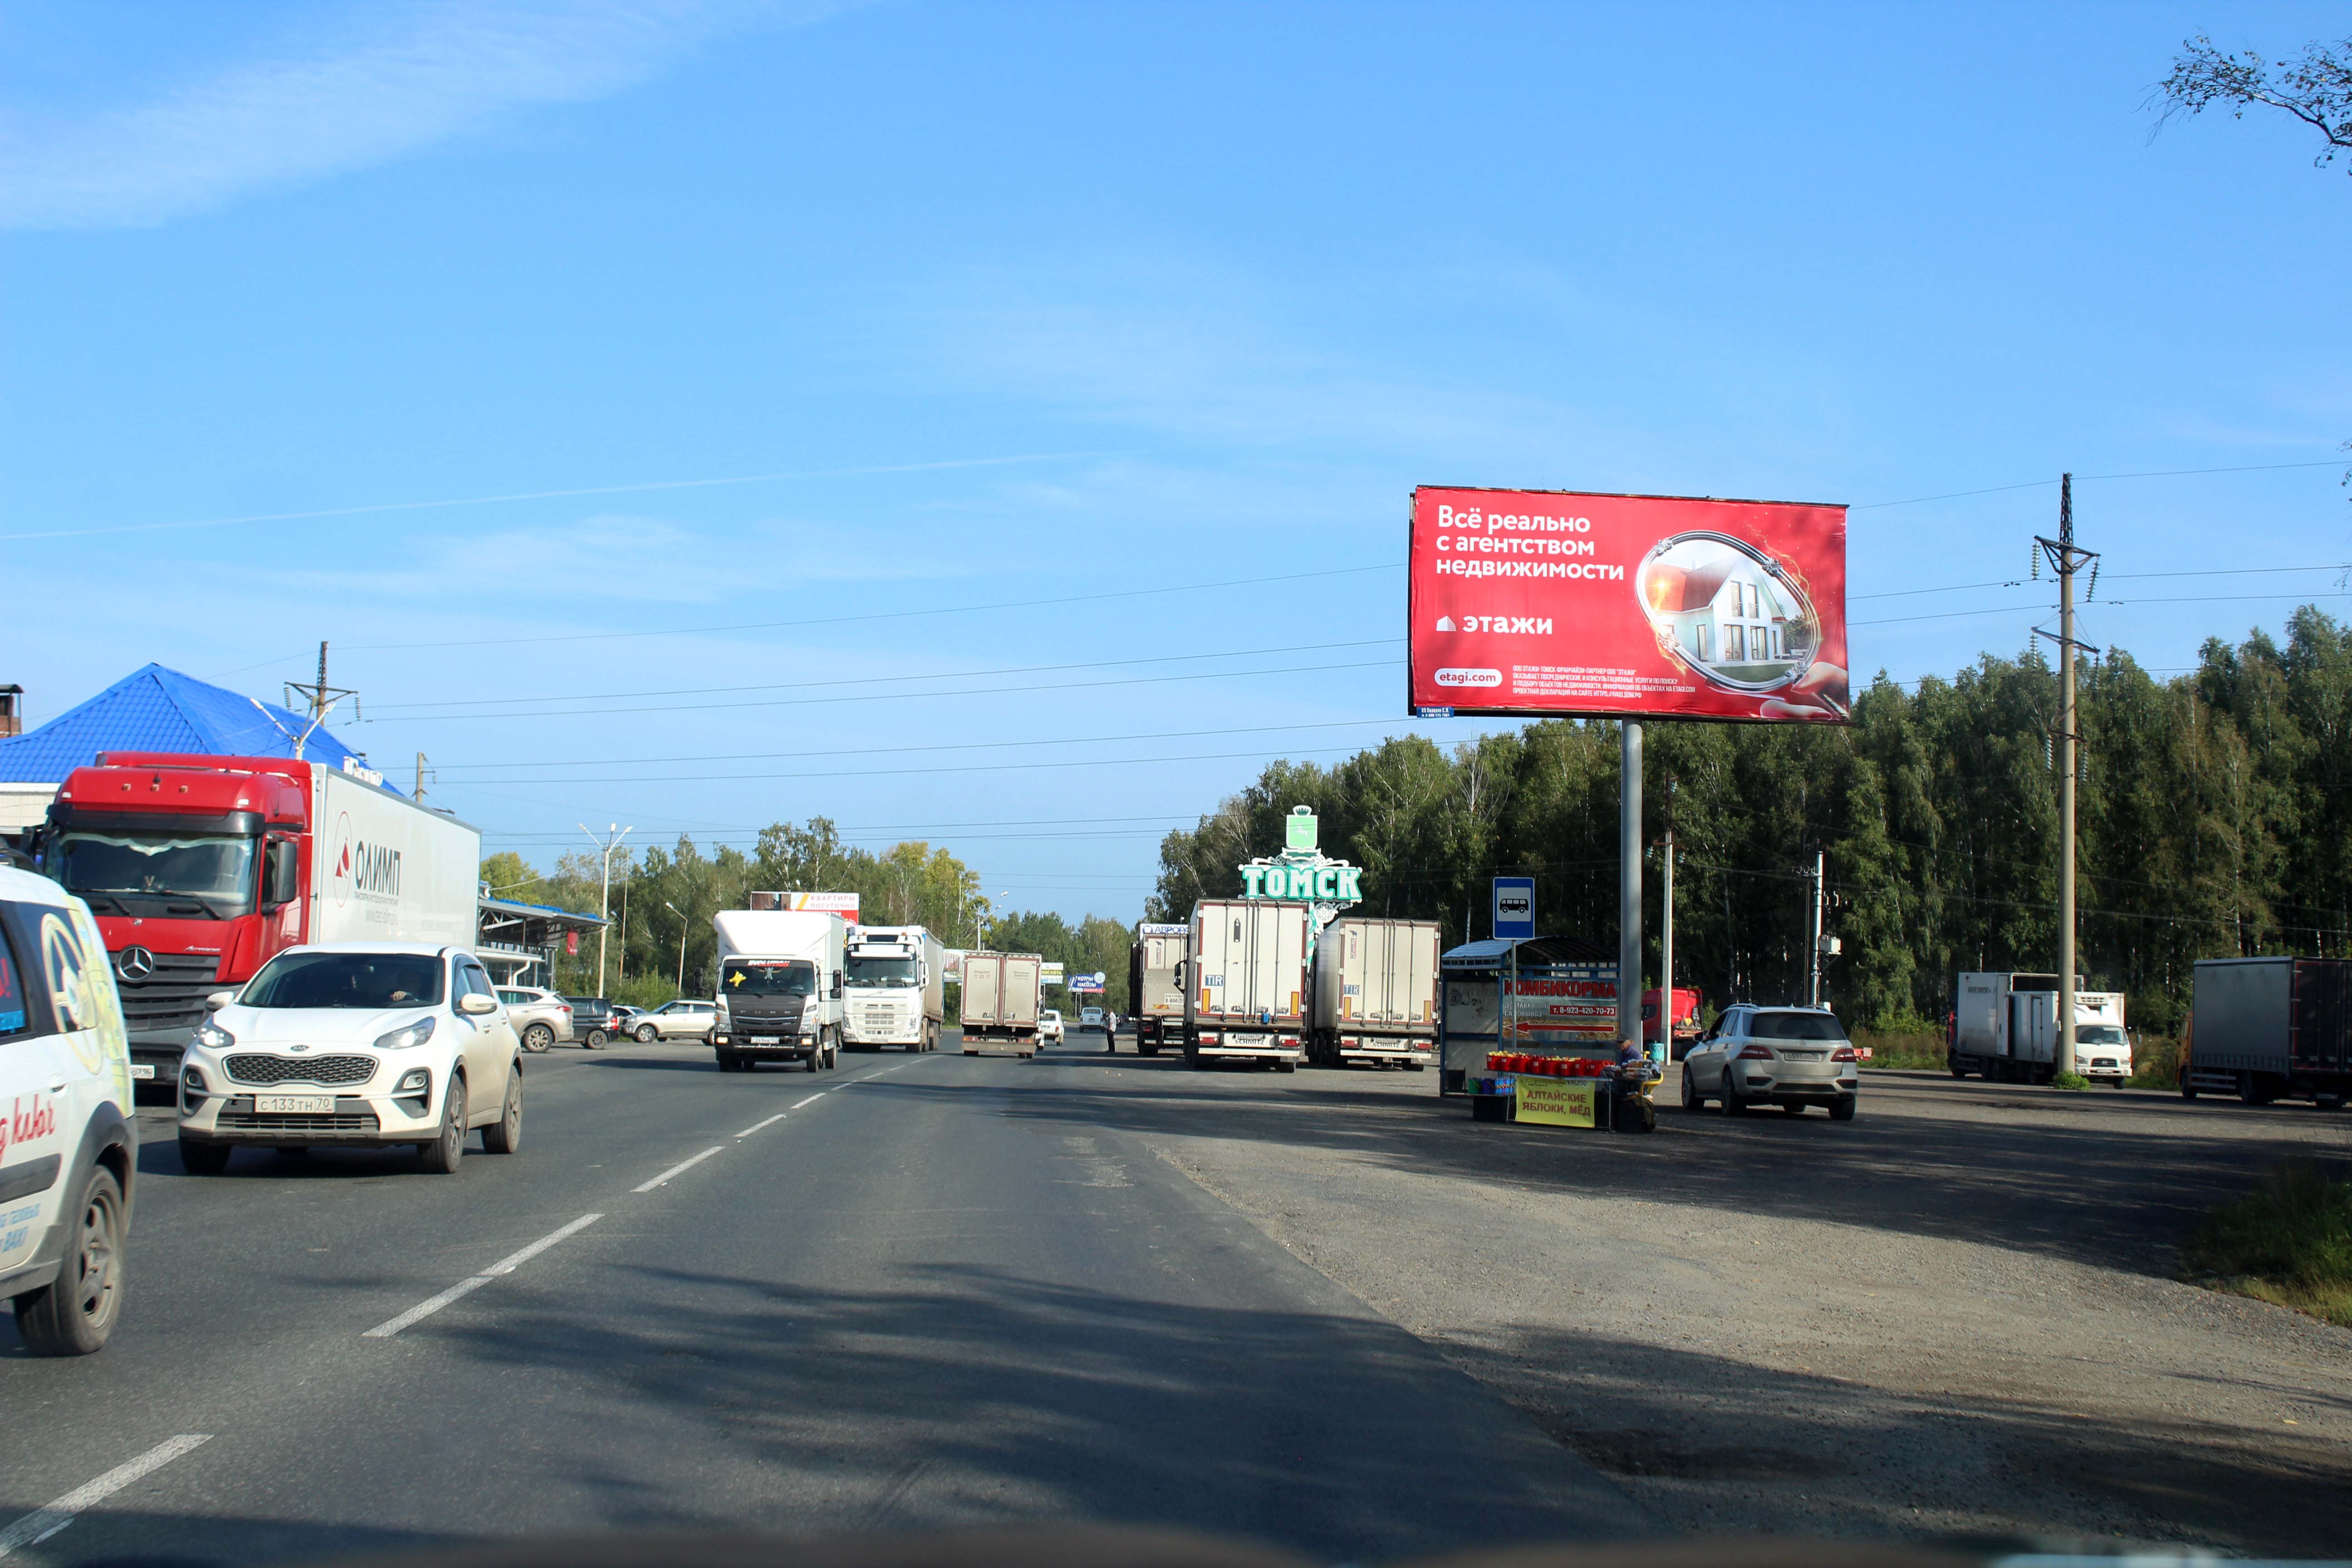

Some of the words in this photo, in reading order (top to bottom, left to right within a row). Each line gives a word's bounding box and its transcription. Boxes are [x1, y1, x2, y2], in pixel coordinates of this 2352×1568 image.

[1438, 505, 1482, 529] Всё
[1488, 513, 1591, 535] реально
[1436, 535, 1450, 551] с
[1455, 535, 1594, 556] агентством
[1436, 559, 1624, 580] недвижимости
[1462, 615, 1553, 635] этажи
[1440, 671, 1496, 684] etagi.com
[355, 840, 401, 897] ОЛИМП
[1242, 867, 1362, 900] ТОМСК
[1206, 975, 1222, 985] TIR
[1504, 979, 1617, 998] КОМБИКОРМА
[1345, 985, 1359, 995] TIR
[1560, 1007, 1615, 1015] 8-923-420-70-73
[1527, 1090, 1587, 1103] АЛТАЙСКИЕ
[1522, 1102, 1567, 1115] ЯБЛОКИ,
[1569, 1104, 1591, 1117] МЁД
